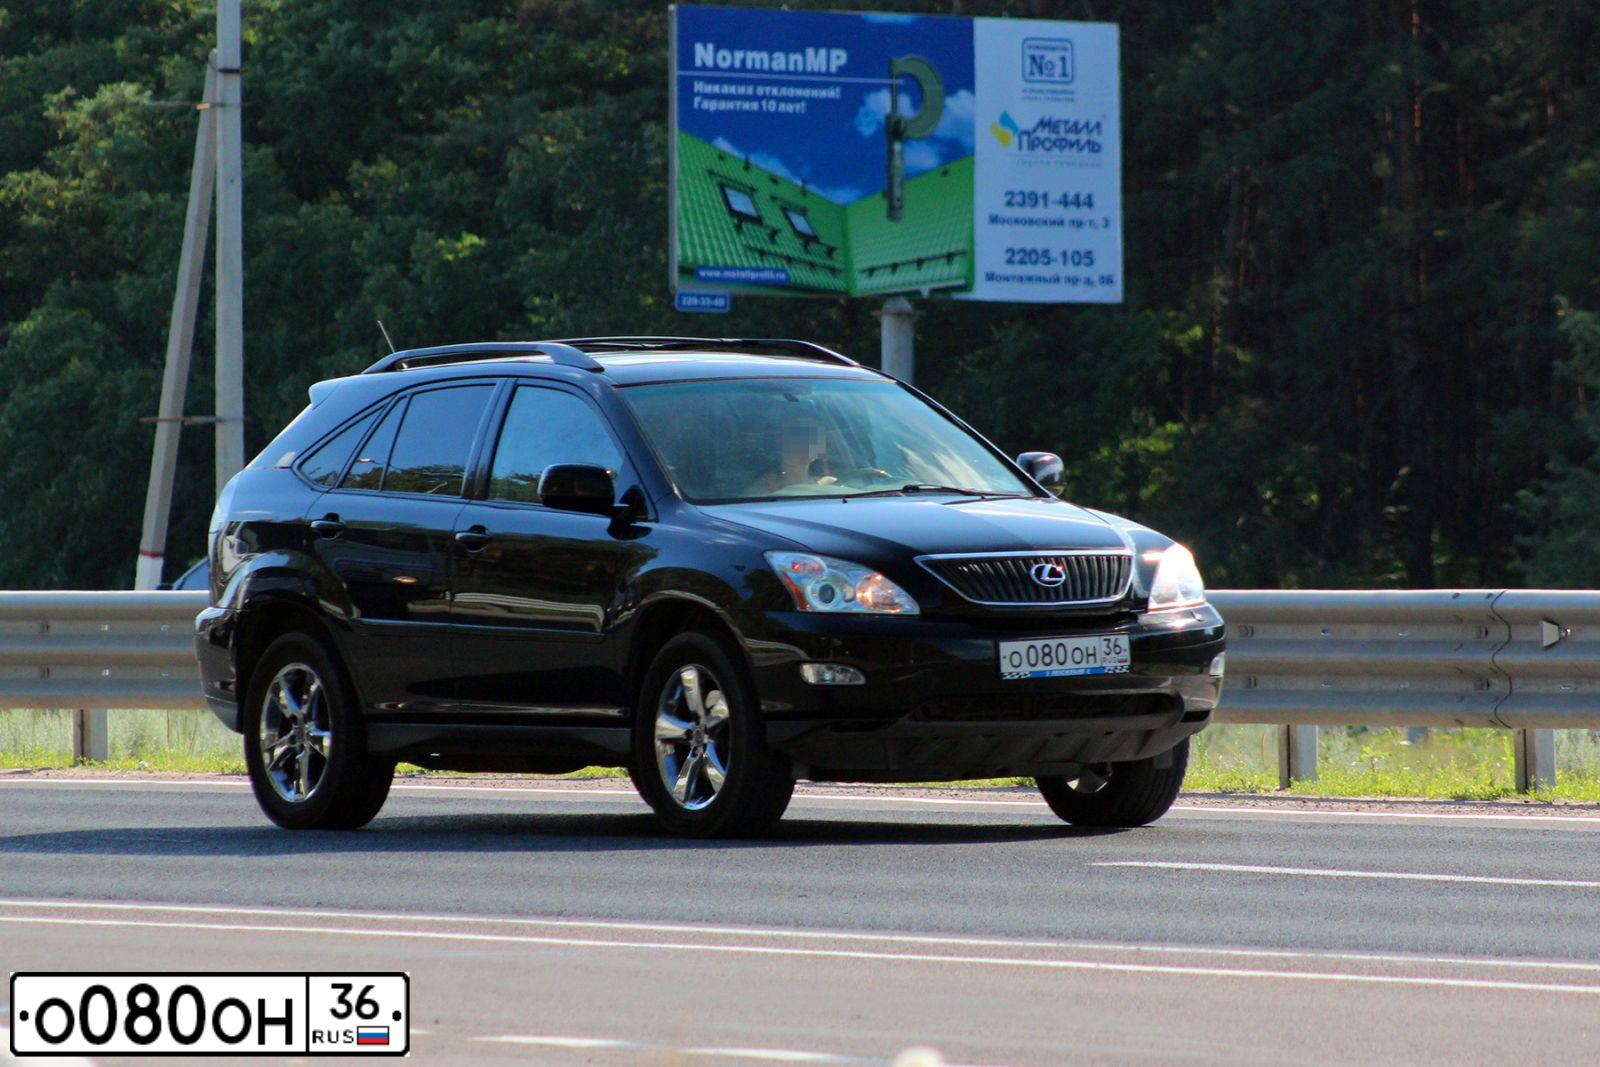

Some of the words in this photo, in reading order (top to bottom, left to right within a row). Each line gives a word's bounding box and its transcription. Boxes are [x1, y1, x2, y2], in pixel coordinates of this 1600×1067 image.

[694, 42, 848, 73] NormanMP
[693, 81, 754, 95] Никаких
[756, 85, 841, 99] отклонений!
[693, 96, 759, 112] Гарантия
[761, 99, 777, 112] 10
[778, 101, 806, 113] лет!
[1005, 190, 1094, 209] 2391-444
[988, 213, 1065, 226] Московский
[1101, 216, 1109, 229] 3
[1005, 247, 1094, 267] 2205-105
[984, 271, 1060, 284] Монтажный
[1103, 637, 1122, 656] 36
